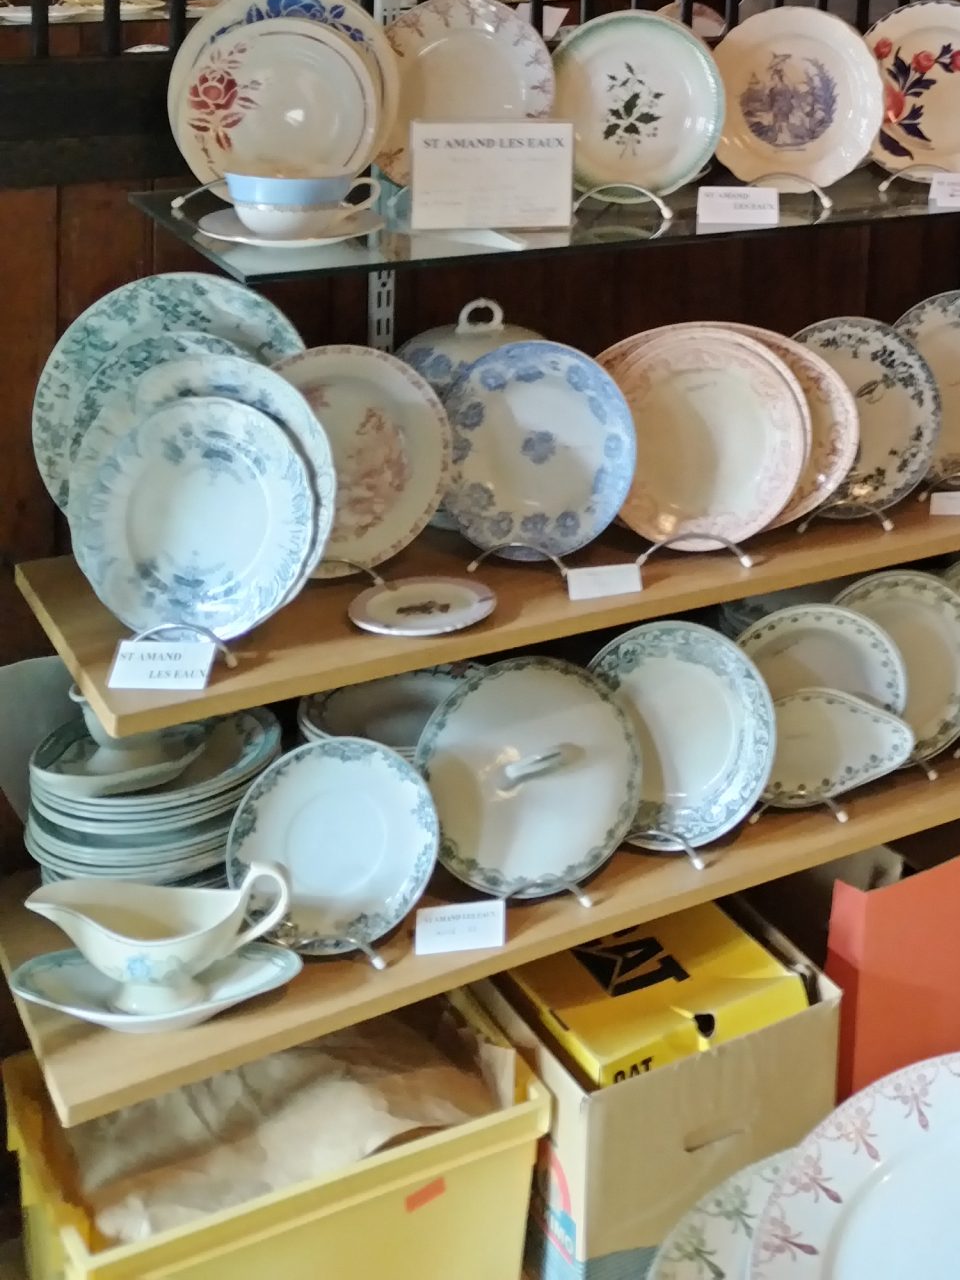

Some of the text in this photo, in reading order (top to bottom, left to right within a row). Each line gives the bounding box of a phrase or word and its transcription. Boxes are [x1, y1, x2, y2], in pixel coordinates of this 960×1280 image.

[423, 137, 565, 149] ST AMAND LES EAUX
[120, 652, 183, 661] ST AMAND
[148, 669, 207, 679] LES EAUX
[573, 926, 690, 997] AT
